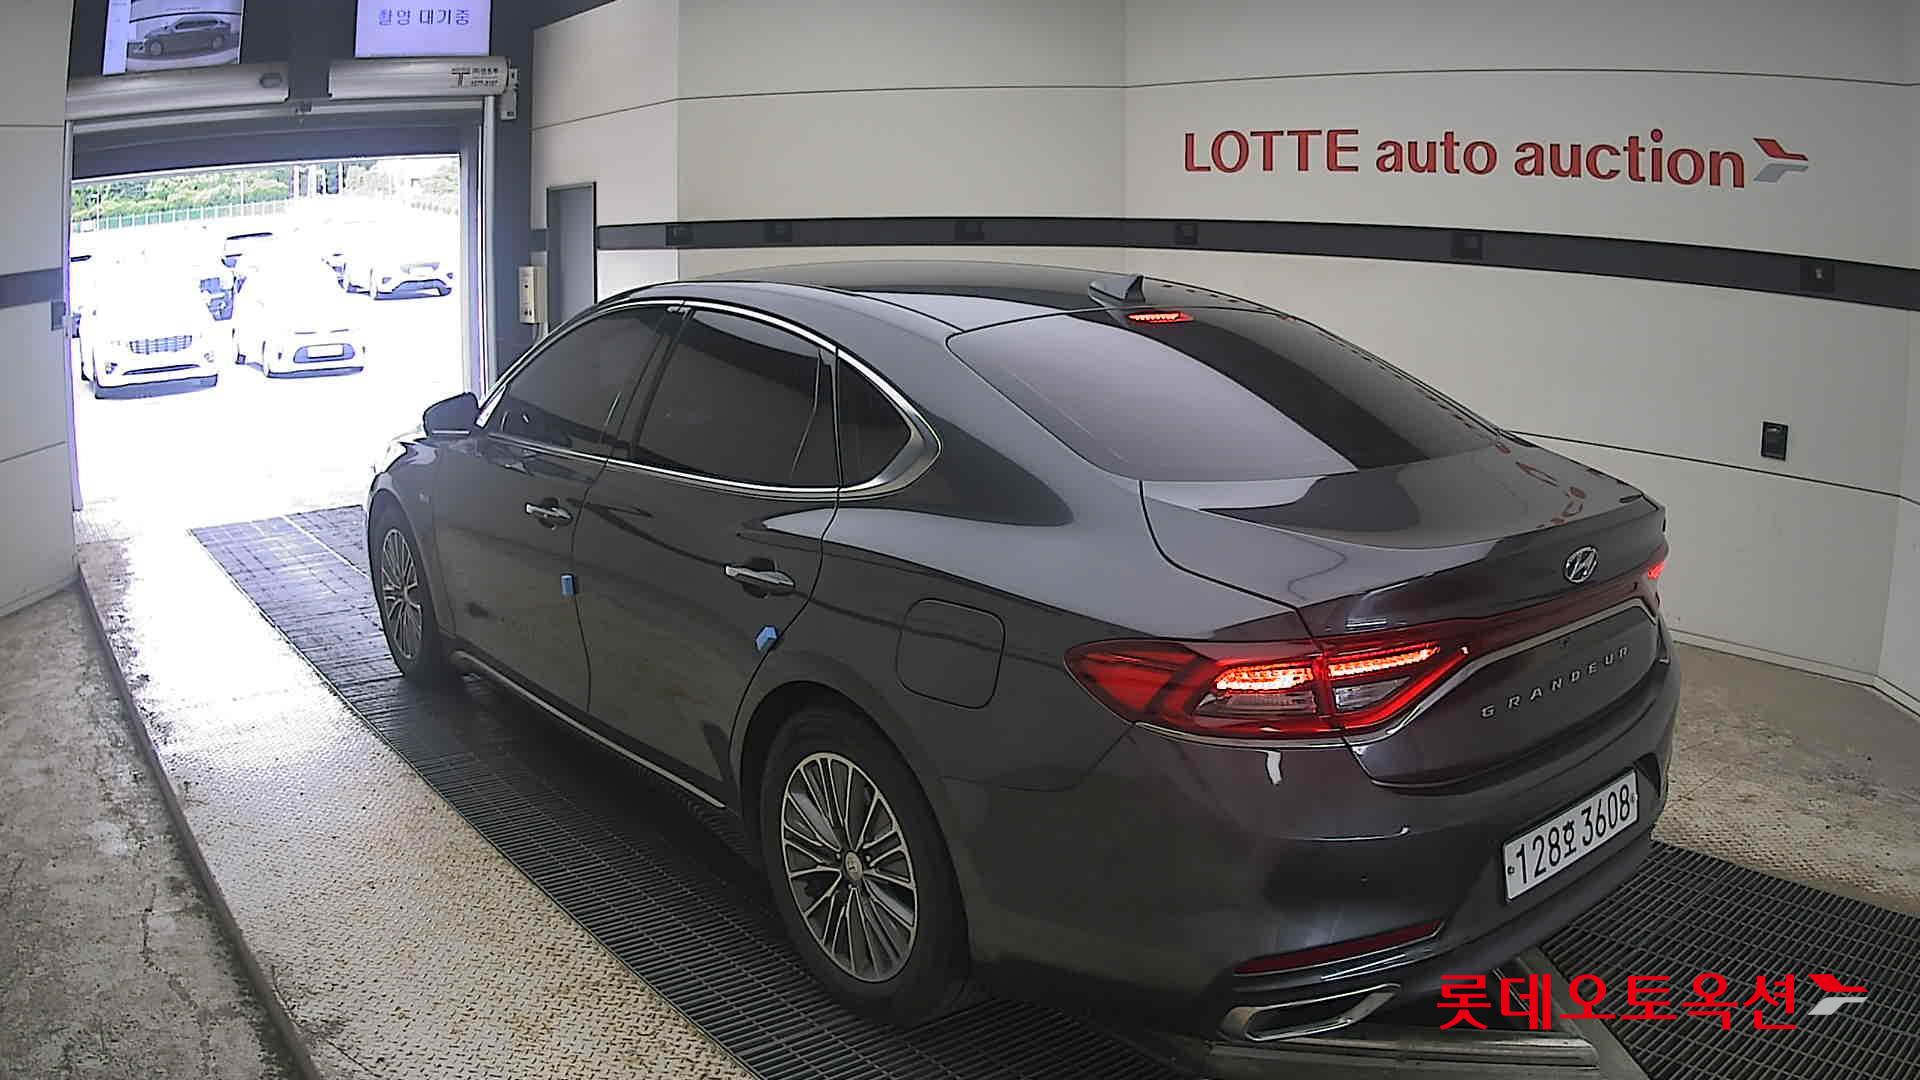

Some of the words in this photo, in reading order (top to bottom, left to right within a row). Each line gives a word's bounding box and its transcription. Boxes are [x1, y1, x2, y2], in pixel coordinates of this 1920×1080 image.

[419, 8, 470, 25] 대기중
[1184, 129, 1360, 173] LOTTE
[1376, 131, 1498, 175] auto
[1514, 128, 1745, 188] auction
[1481, 646, 1629, 718] GRANDEUR
